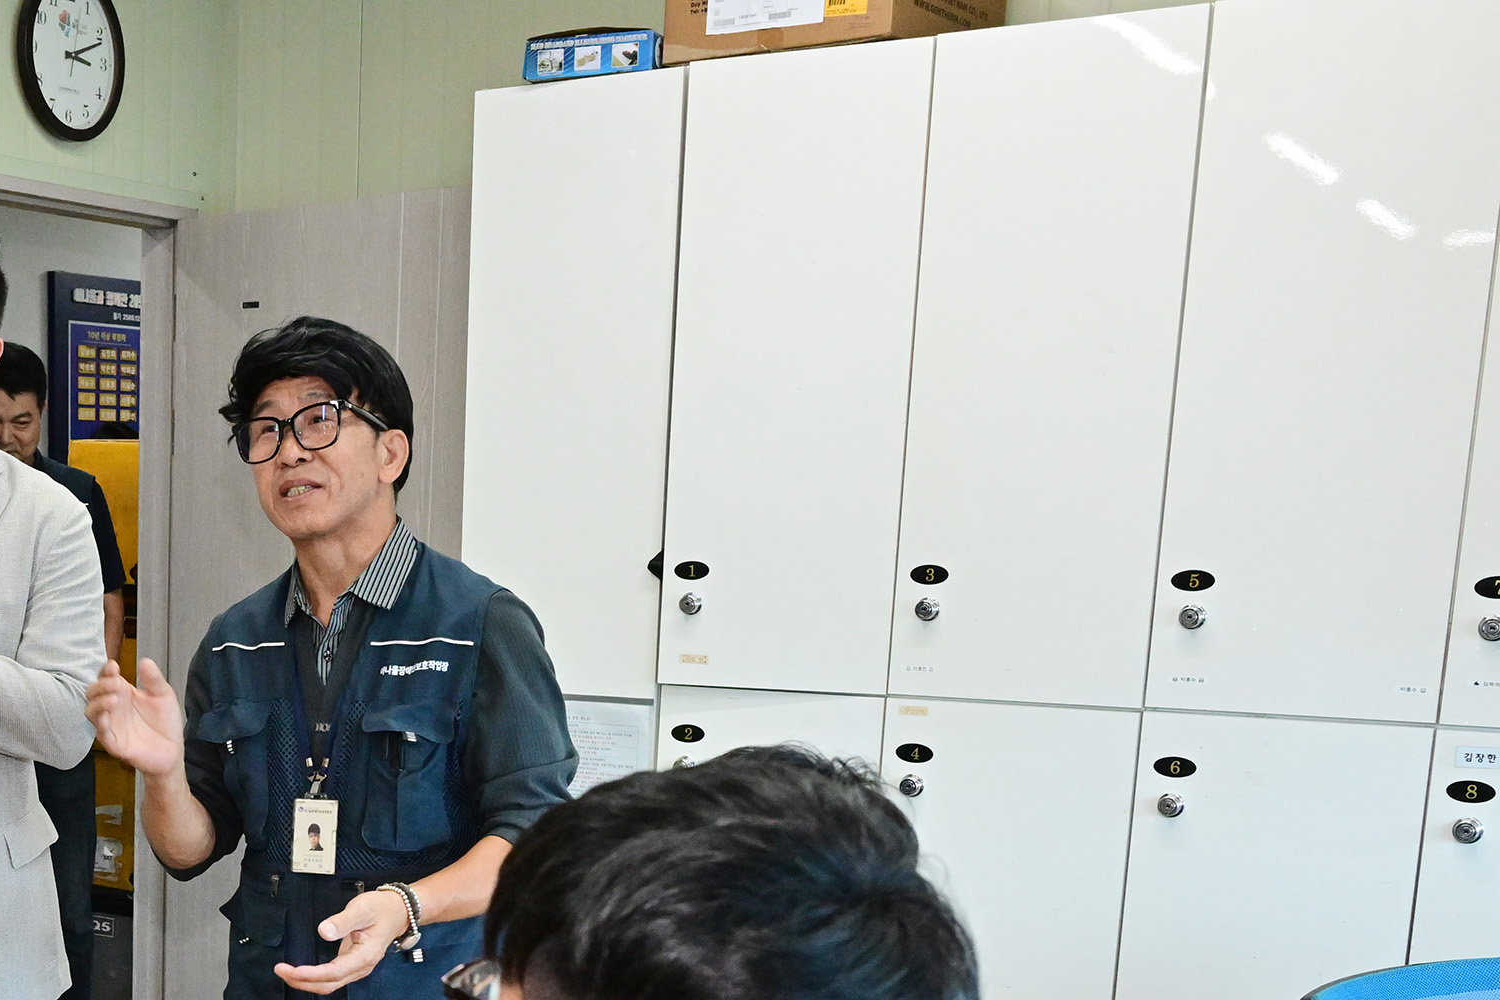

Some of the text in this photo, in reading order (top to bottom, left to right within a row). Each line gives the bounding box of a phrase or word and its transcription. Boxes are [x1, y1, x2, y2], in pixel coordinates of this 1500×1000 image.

[688, 564, 697, 577] 1
[925, 568, 935, 582] 3
[1188, 574, 1199, 588] 5
[683, 727, 693, 740] 2
[910, 747, 920, 760] 4
[1169, 760, 1181, 774] 6
[1465, 784, 1478, 799] 8
